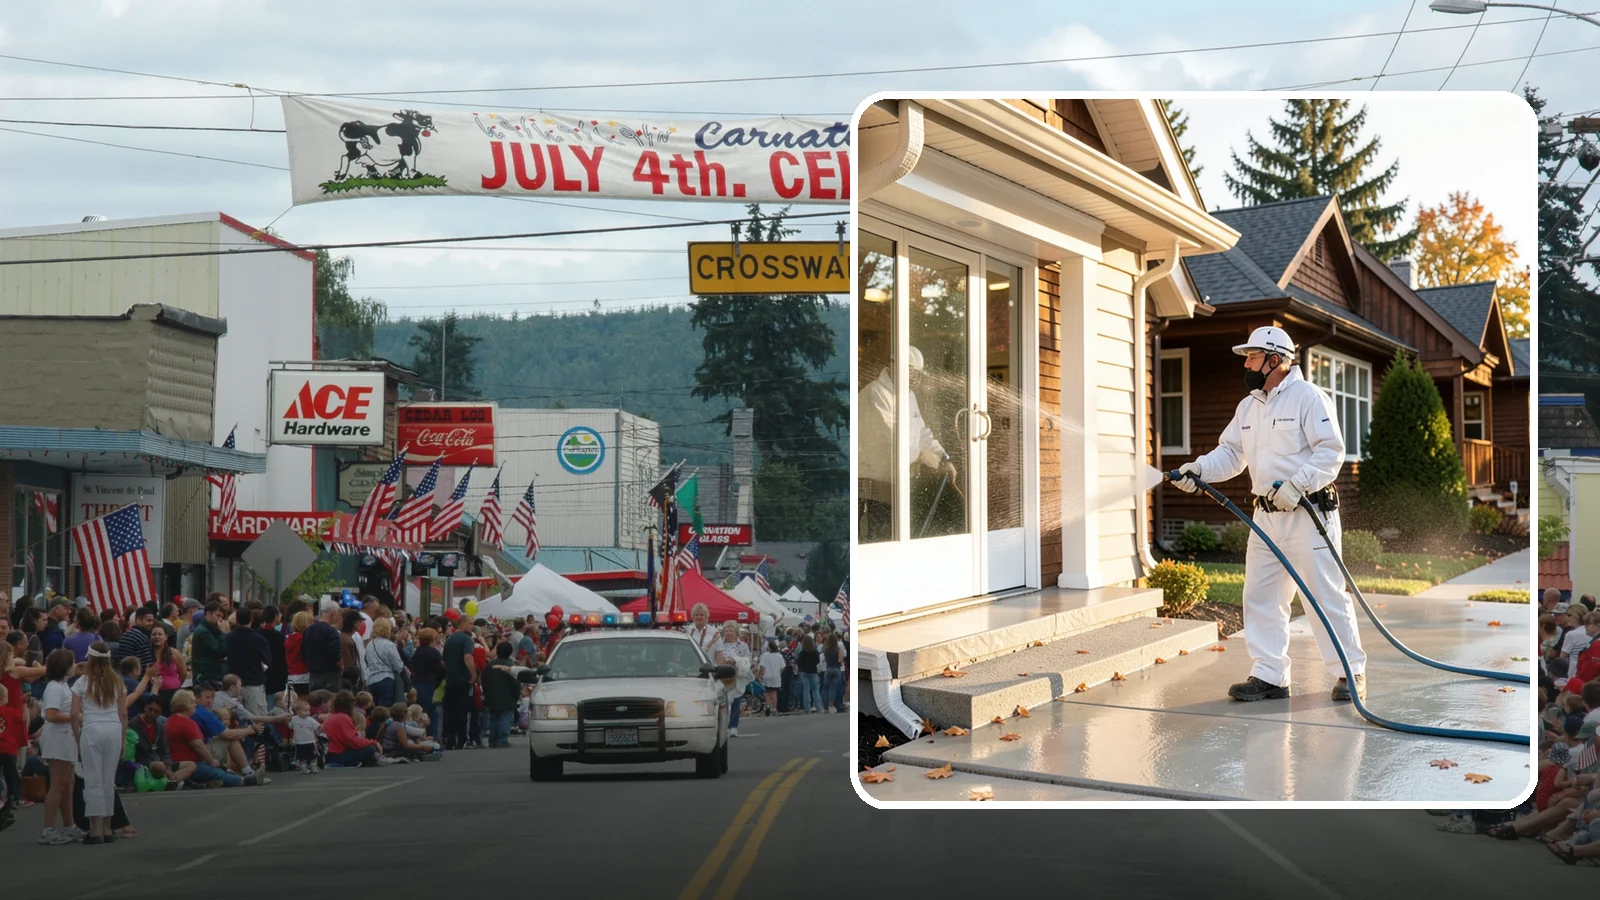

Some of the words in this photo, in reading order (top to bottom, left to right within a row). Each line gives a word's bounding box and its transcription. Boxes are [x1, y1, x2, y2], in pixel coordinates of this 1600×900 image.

[695, 121, 850, 150] Carnat
[481, 141, 604, 193] JULY
[632, 150, 746, 198] 4th.
[697, 254, 850, 280] CROSSWA
[283, 380, 373, 420] ACE
[405, 409, 452, 422] CEDAR
[283, 421, 370, 437] Hardware
[416, 427, 477, 447] Coca-Cola
[353, 467, 384, 480] Simpl
[95, 485, 124, 495] Vincent
[126, 486, 135, 495] de
[137, 486, 155, 495] Paul
[699, 535, 730, 544] GLASS
